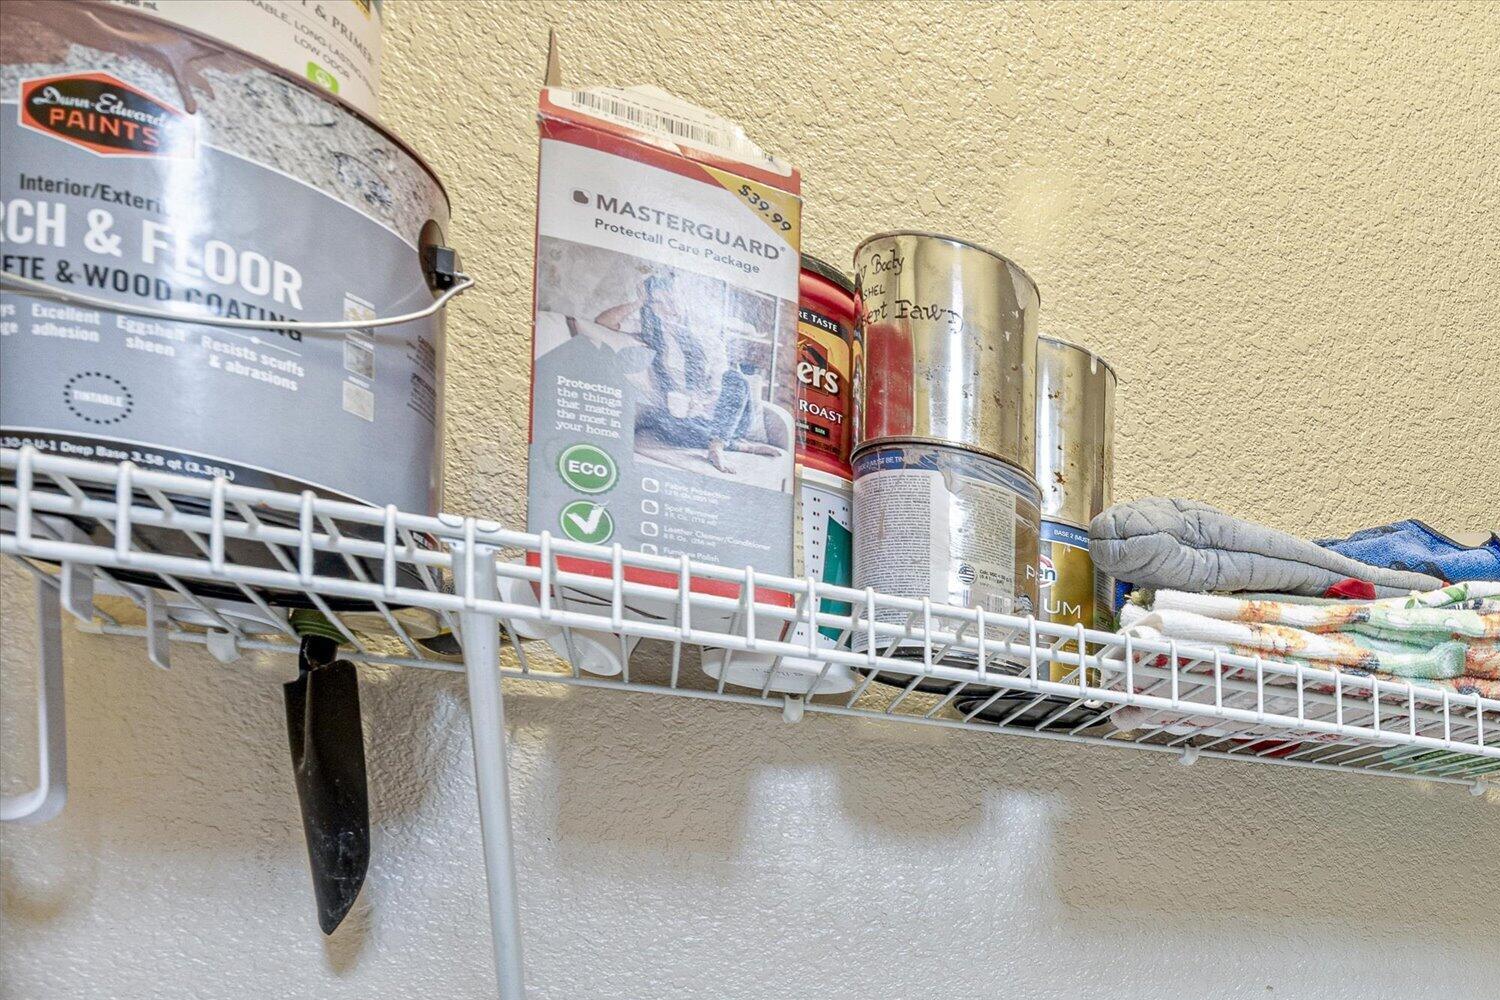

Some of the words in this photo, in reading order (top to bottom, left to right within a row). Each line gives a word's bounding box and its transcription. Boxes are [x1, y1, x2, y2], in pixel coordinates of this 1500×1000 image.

[50, 107, 161, 148] PAINTS
[20, 172, 163, 214] Interior/Exteri
[737, 184, 793, 233] $39.99
[595, 218, 663, 246] Protectall
[667, 237, 700, 256] Care
[704, 248, 761, 275] Package
[84, 208, 122, 258] &
[142, 218, 303, 311] FLOOR
[56, 259, 75, 284] &
[83, 262, 172, 302] WOOD
[31, 303, 100, 325] Excellent
[811, 313, 839, 333] TASTE
[31, 323, 99, 344] adhesion
[116, 315, 186, 343] Eggshell
[125, 336, 175, 358] sheen
[201, 335, 257, 362] Resists
[261, 353, 305, 378] scuffs
[208, 353, 221, 368] &
[225, 358, 299, 392] abrasions
[797, 361, 839, 394] ers
[557, 375, 622, 399] Protecting
[557, 387, 579, 399] the
[582, 392, 622, 409] things
[556, 409, 576, 420] the
[579, 413, 608, 426] most
[610, 418, 622, 429] in
[557, 398, 580, 411] that
[585, 404, 622, 418] matter
[799, 399, 843, 424] ROAST
[555, 420, 582, 433] your
[585, 423, 621, 440] home.
[60, 441, 94, 457] Deep
[95, 445, 129, 460] Base
[568, 460, 608, 479] ECO
[1053, 529, 1070, 538] BASE
[1043, 597, 1081, 619] UM
